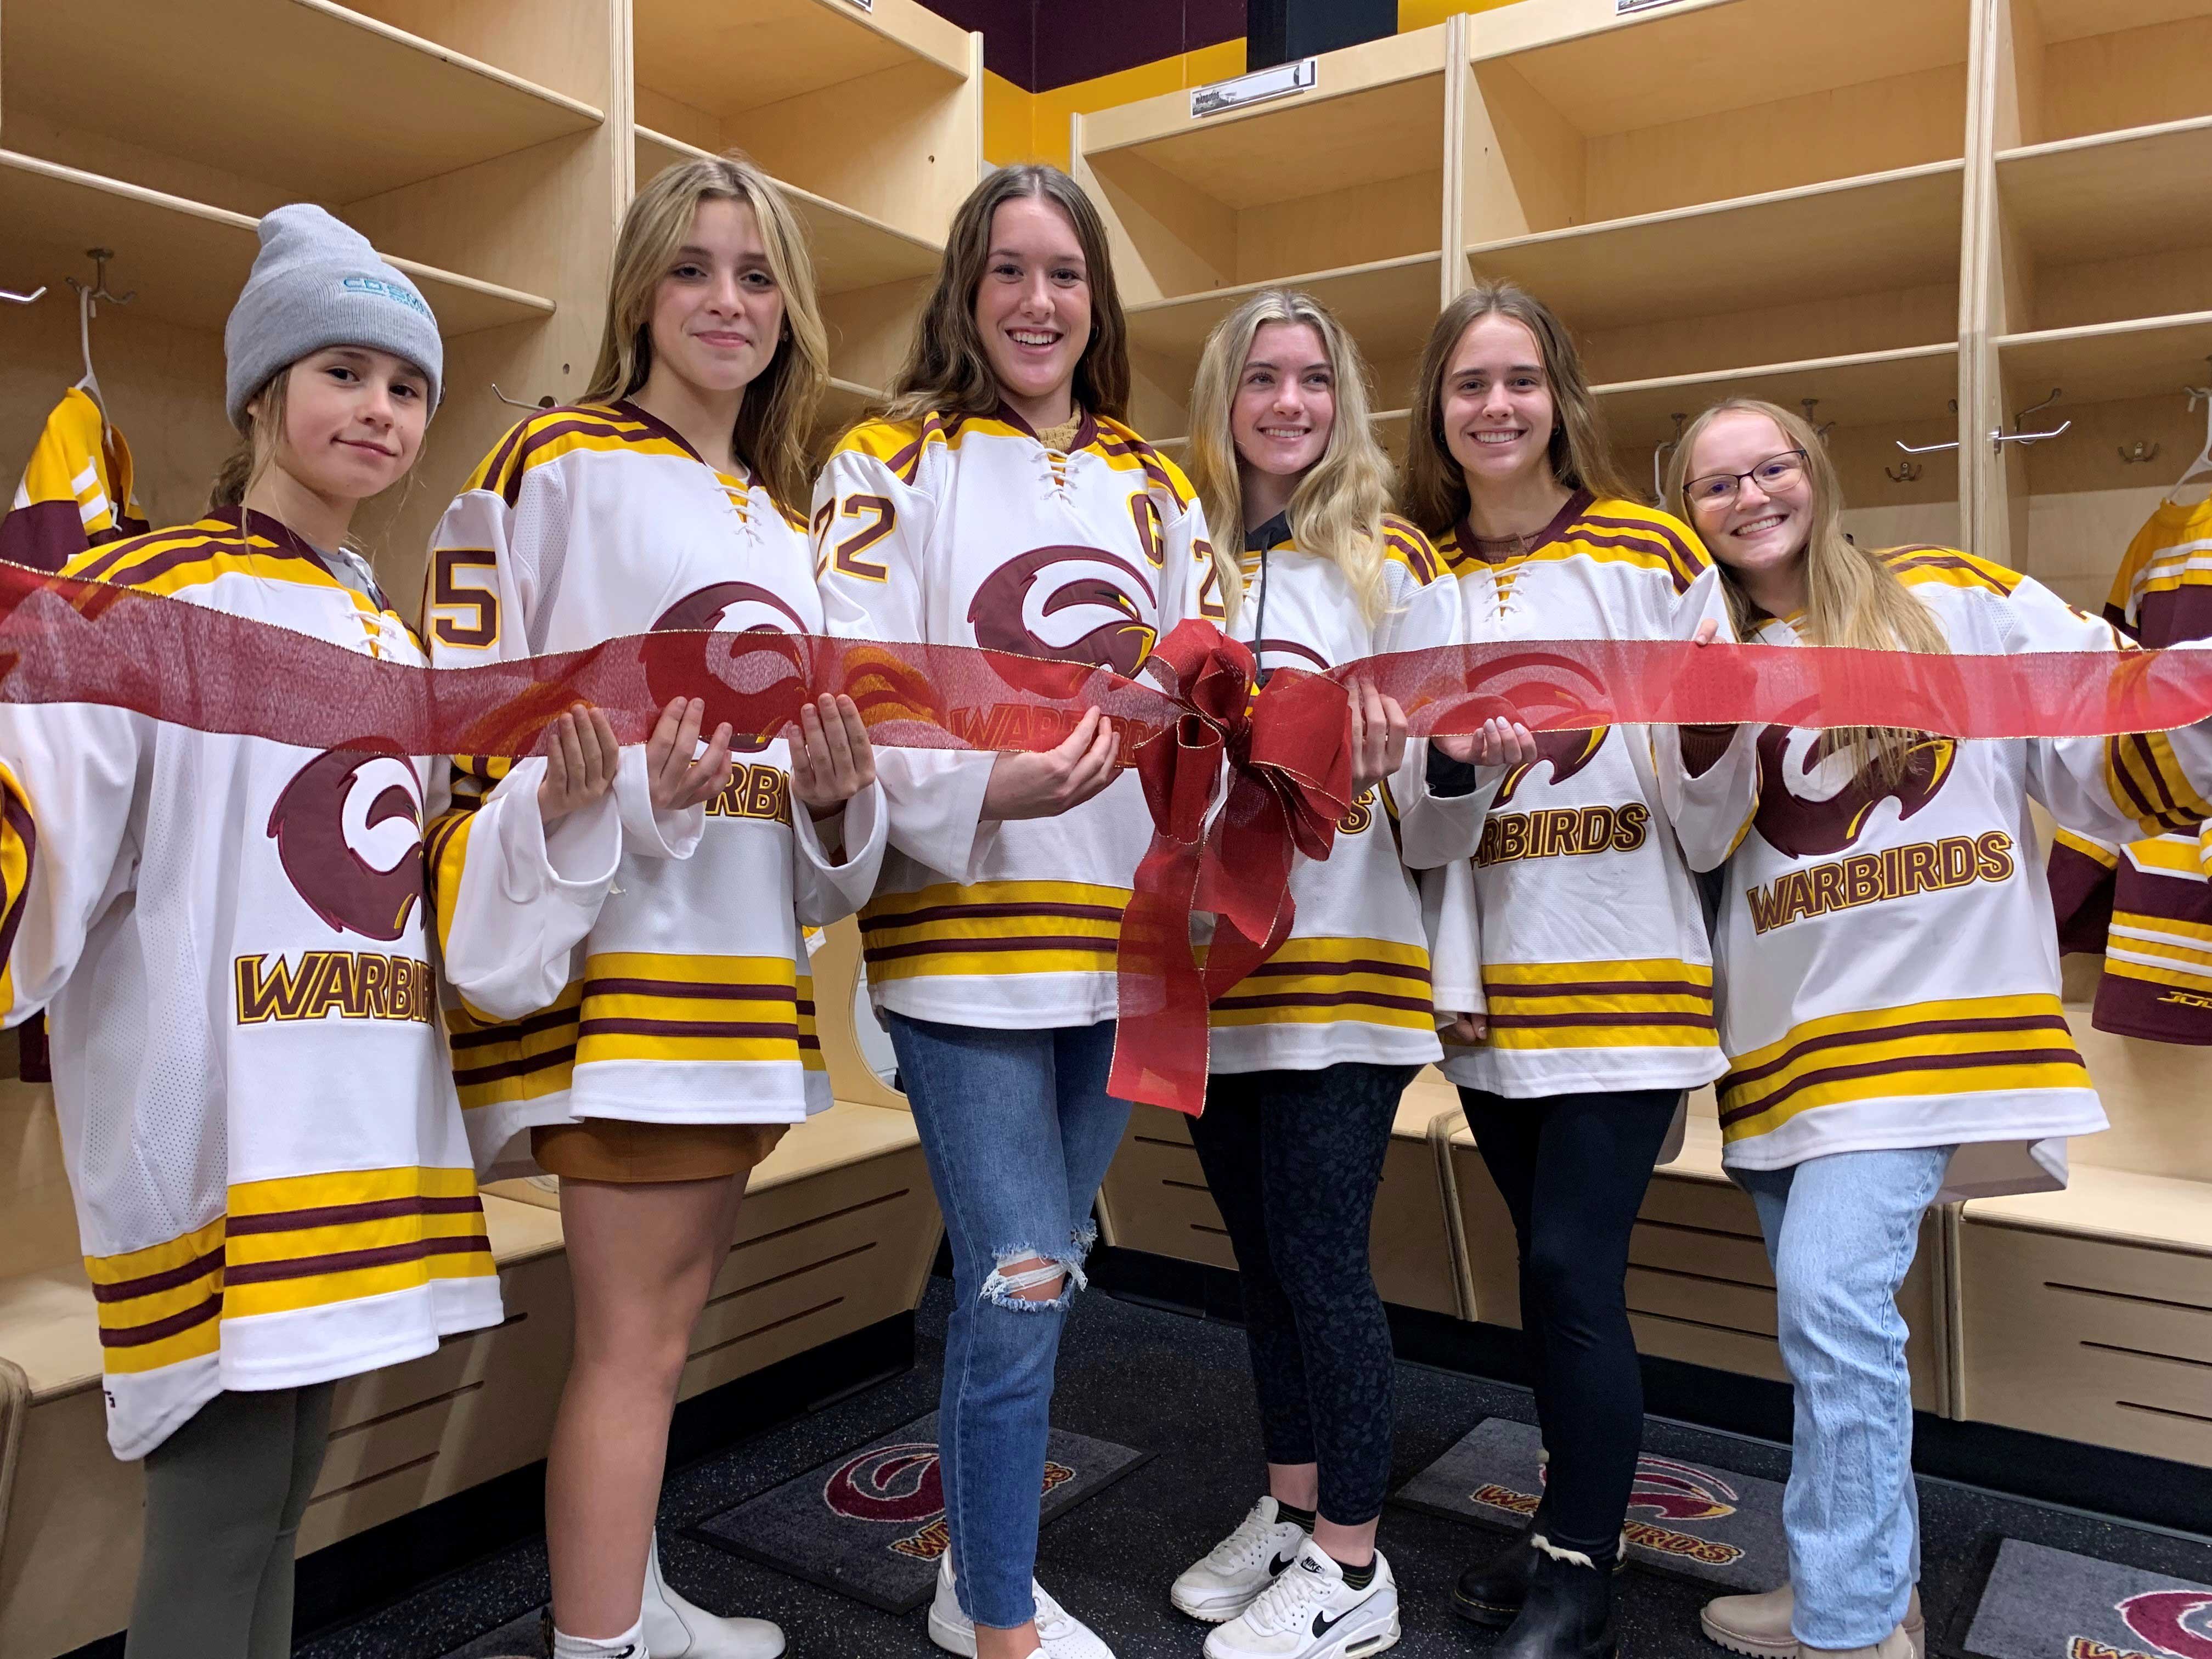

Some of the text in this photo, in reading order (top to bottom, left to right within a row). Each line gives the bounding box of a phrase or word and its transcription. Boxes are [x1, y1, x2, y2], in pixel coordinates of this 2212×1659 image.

[1126, 490, 1164, 569] C
[1746, 831, 2015, 935] WARBIRDS
[1304, 1556, 1323, 1572] NIKE
